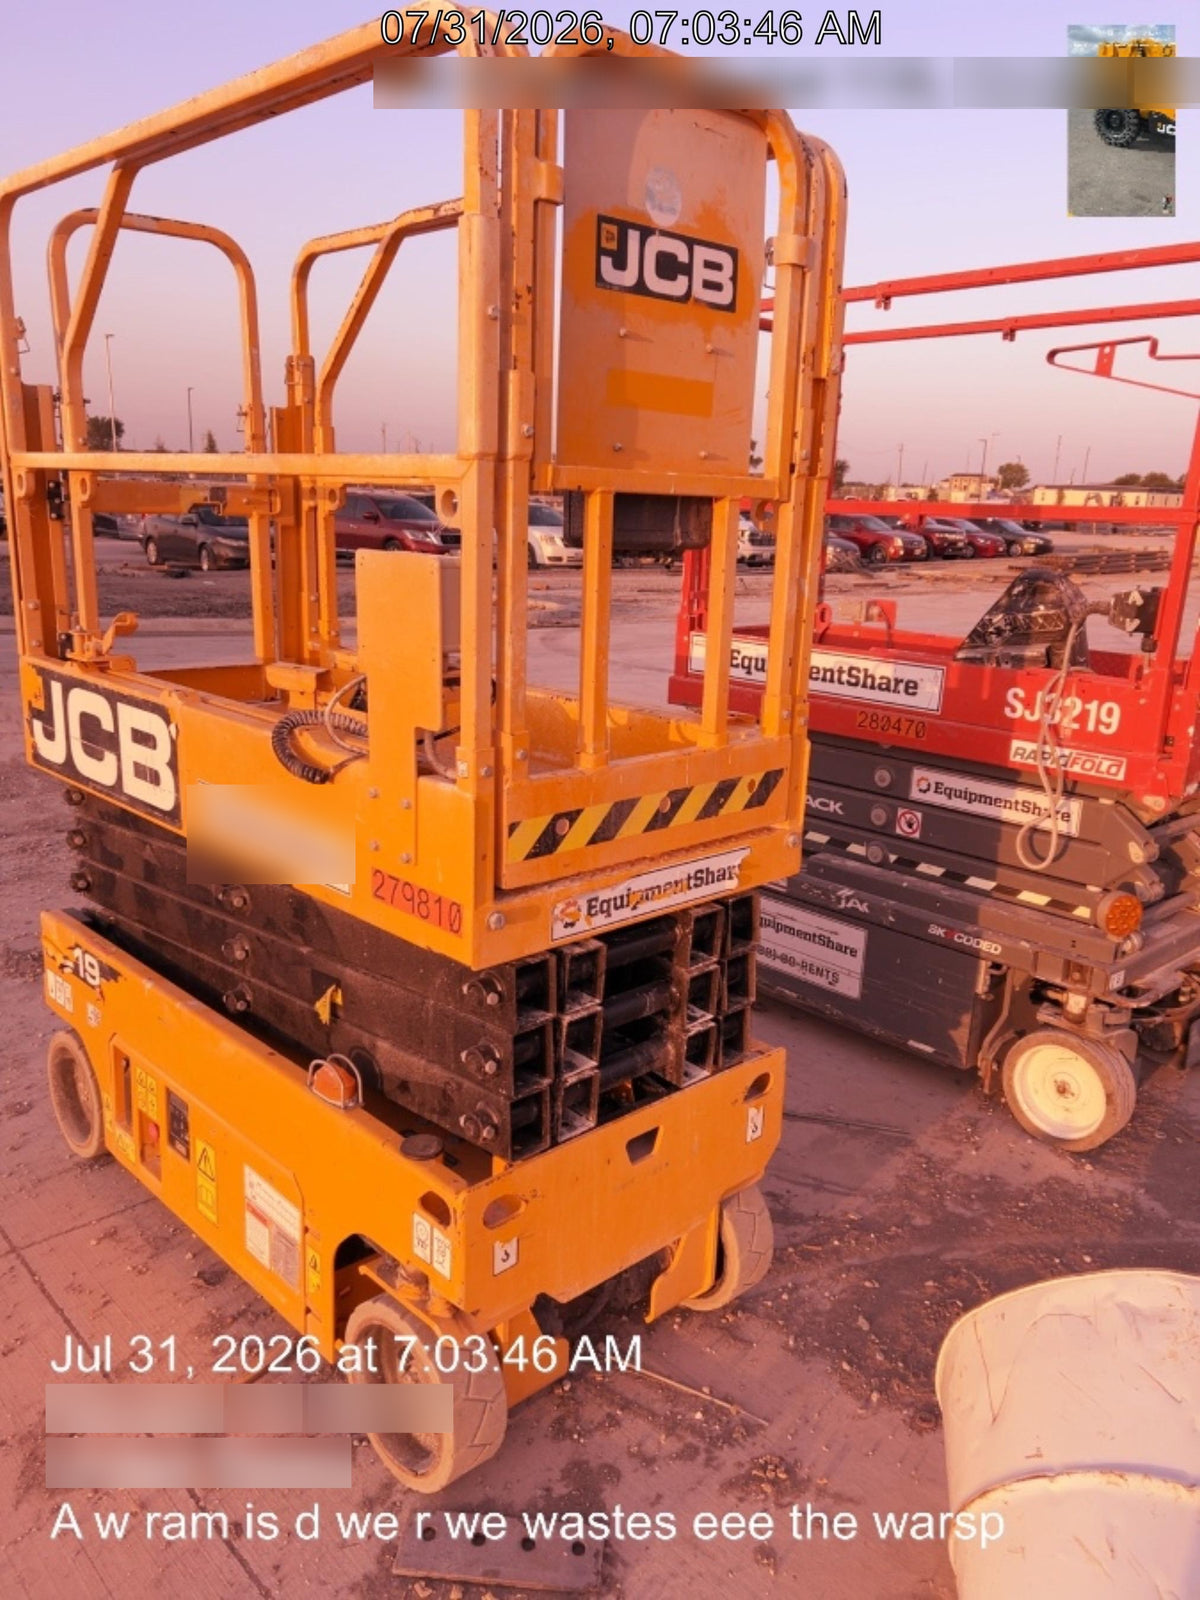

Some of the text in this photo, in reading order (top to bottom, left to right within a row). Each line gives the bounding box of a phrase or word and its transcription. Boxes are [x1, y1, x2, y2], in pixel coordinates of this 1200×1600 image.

[600, 228, 734, 305] JCB
[730, 649, 919, 697] EquentShare
[858, 710, 926, 739] 280470
[1004, 687, 1121, 735] SJ3219
[32, 680, 176, 812] JCB
[805, 794, 845, 815] ACK
[373, 869, 462, 934] 279810
[586, 863, 742, 919] EquipmentShar
[760, 915, 858, 958] uipmentShare
